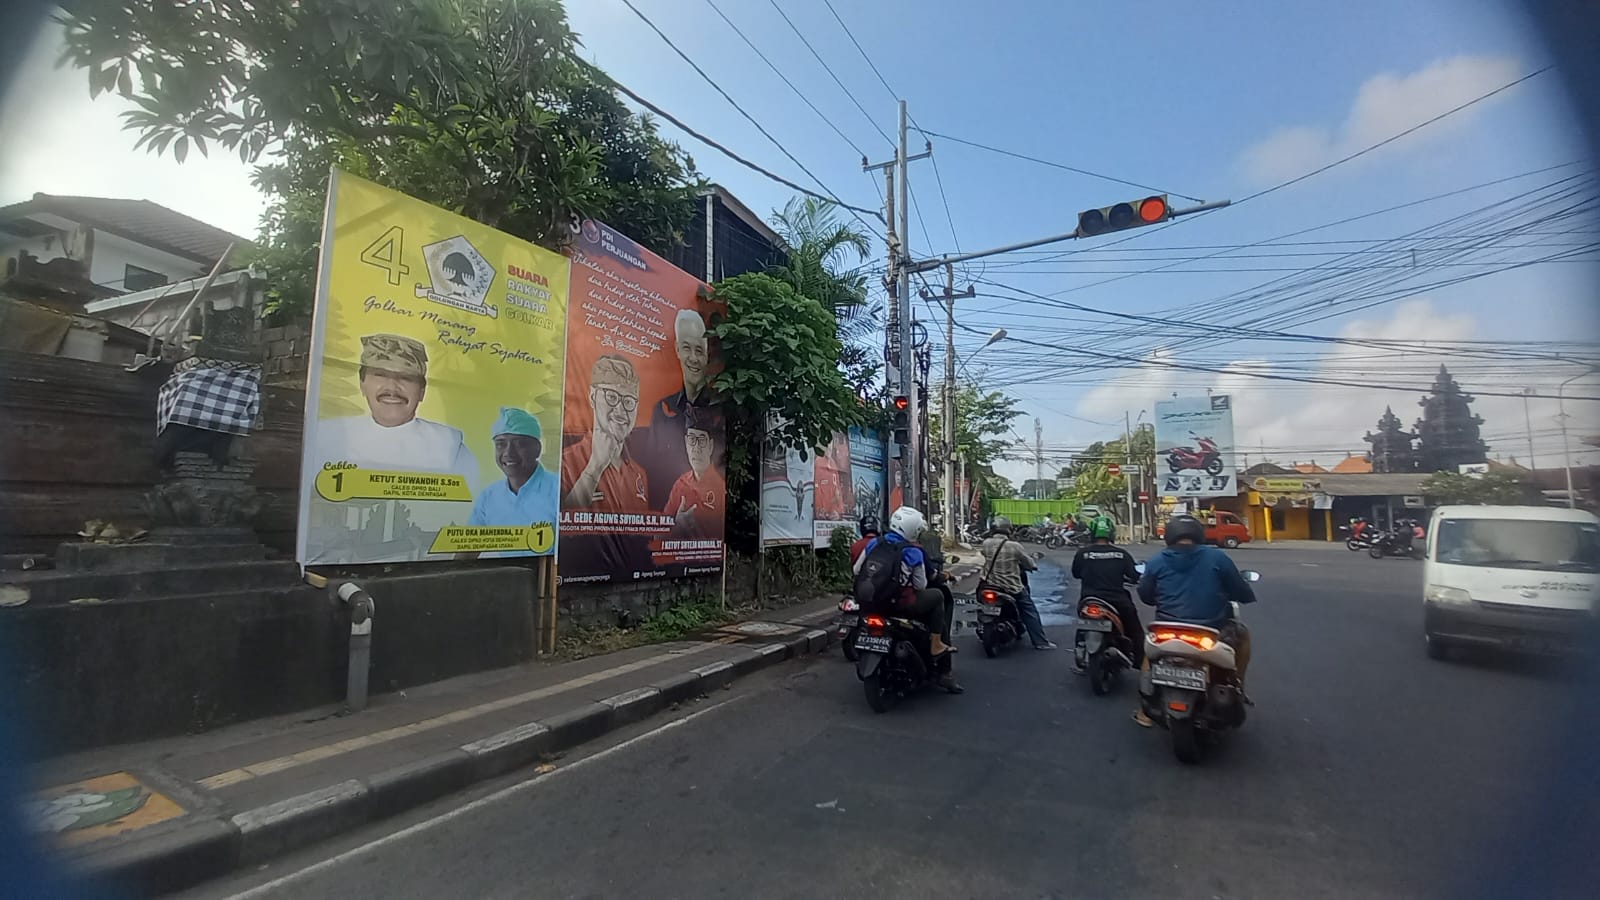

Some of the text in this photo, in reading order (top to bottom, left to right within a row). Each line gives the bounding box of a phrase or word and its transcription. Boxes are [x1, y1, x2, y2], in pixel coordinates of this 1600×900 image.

[569, 212, 581, 234] 3
[601, 229, 614, 242] PDI
[361, 225, 409, 286] 4
[601, 239, 647, 270] PERJUANGAN
[507, 264, 549, 288] SUARA
[507, 279, 552, 302] RAKYAT
[429, 294, 465, 309] GOLONGAN
[506, 294, 547, 314] SUARA
[363, 295, 477, 336] Golkar Menang
[505, 307, 554, 330] GOLKAR
[584, 313, 608, 331] Tanah
[437, 329, 544, 365] Rakyat Sejahtera
[323, 460, 358, 471] Coblos
[332, 472, 343, 493] 1
[369, 474, 396, 484] KETUT
[398, 475, 439, 486] SUWANDHI
[573, 512, 593, 523] GEDE
[594, 512, 620, 524] AGUNG
[446, 529, 464, 537] PUTU
[466, 528, 478, 536] OKA
[536, 530, 543, 546] 1
